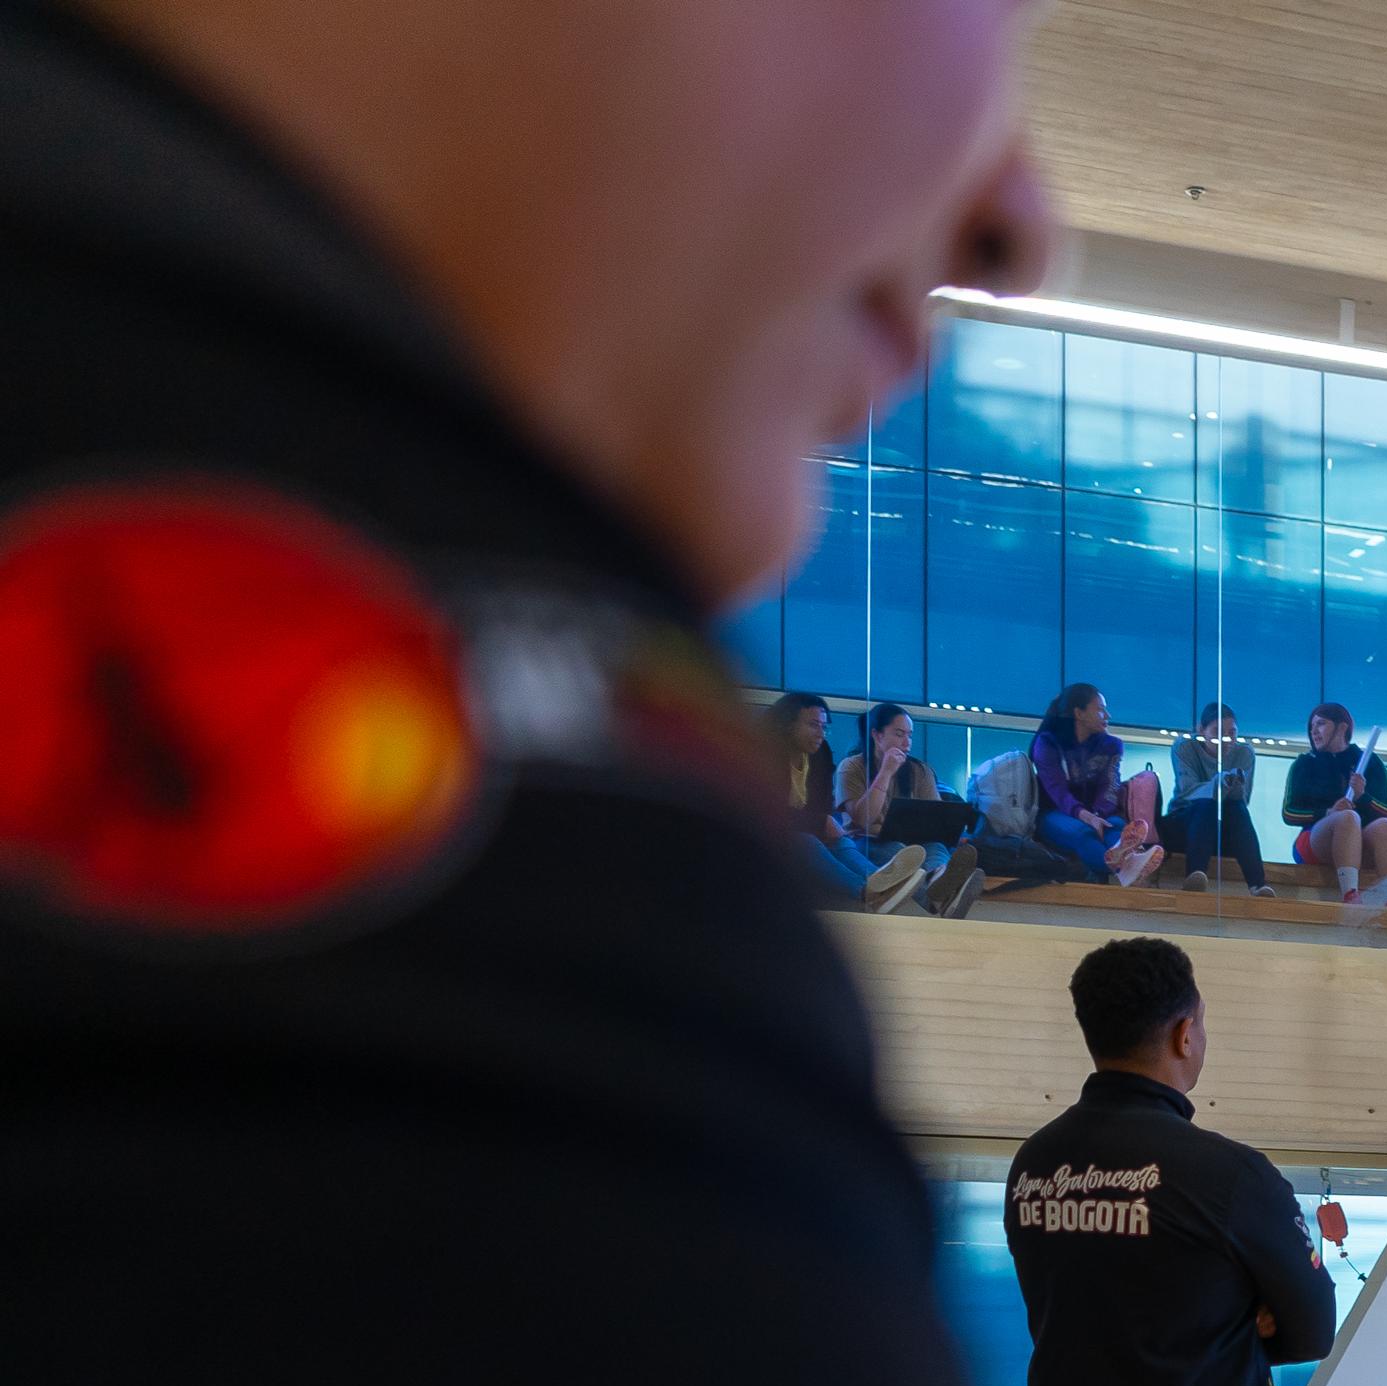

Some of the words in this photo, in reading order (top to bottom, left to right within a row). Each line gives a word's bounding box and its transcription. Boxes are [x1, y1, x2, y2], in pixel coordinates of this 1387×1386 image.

[1013, 1171, 1044, 1200] Liga
[1053, 1164, 1161, 1198] Baloncesto
[1019, 1201, 1042, 1226] DE
[1045, 1198, 1149, 1235] BOGOTÁ
